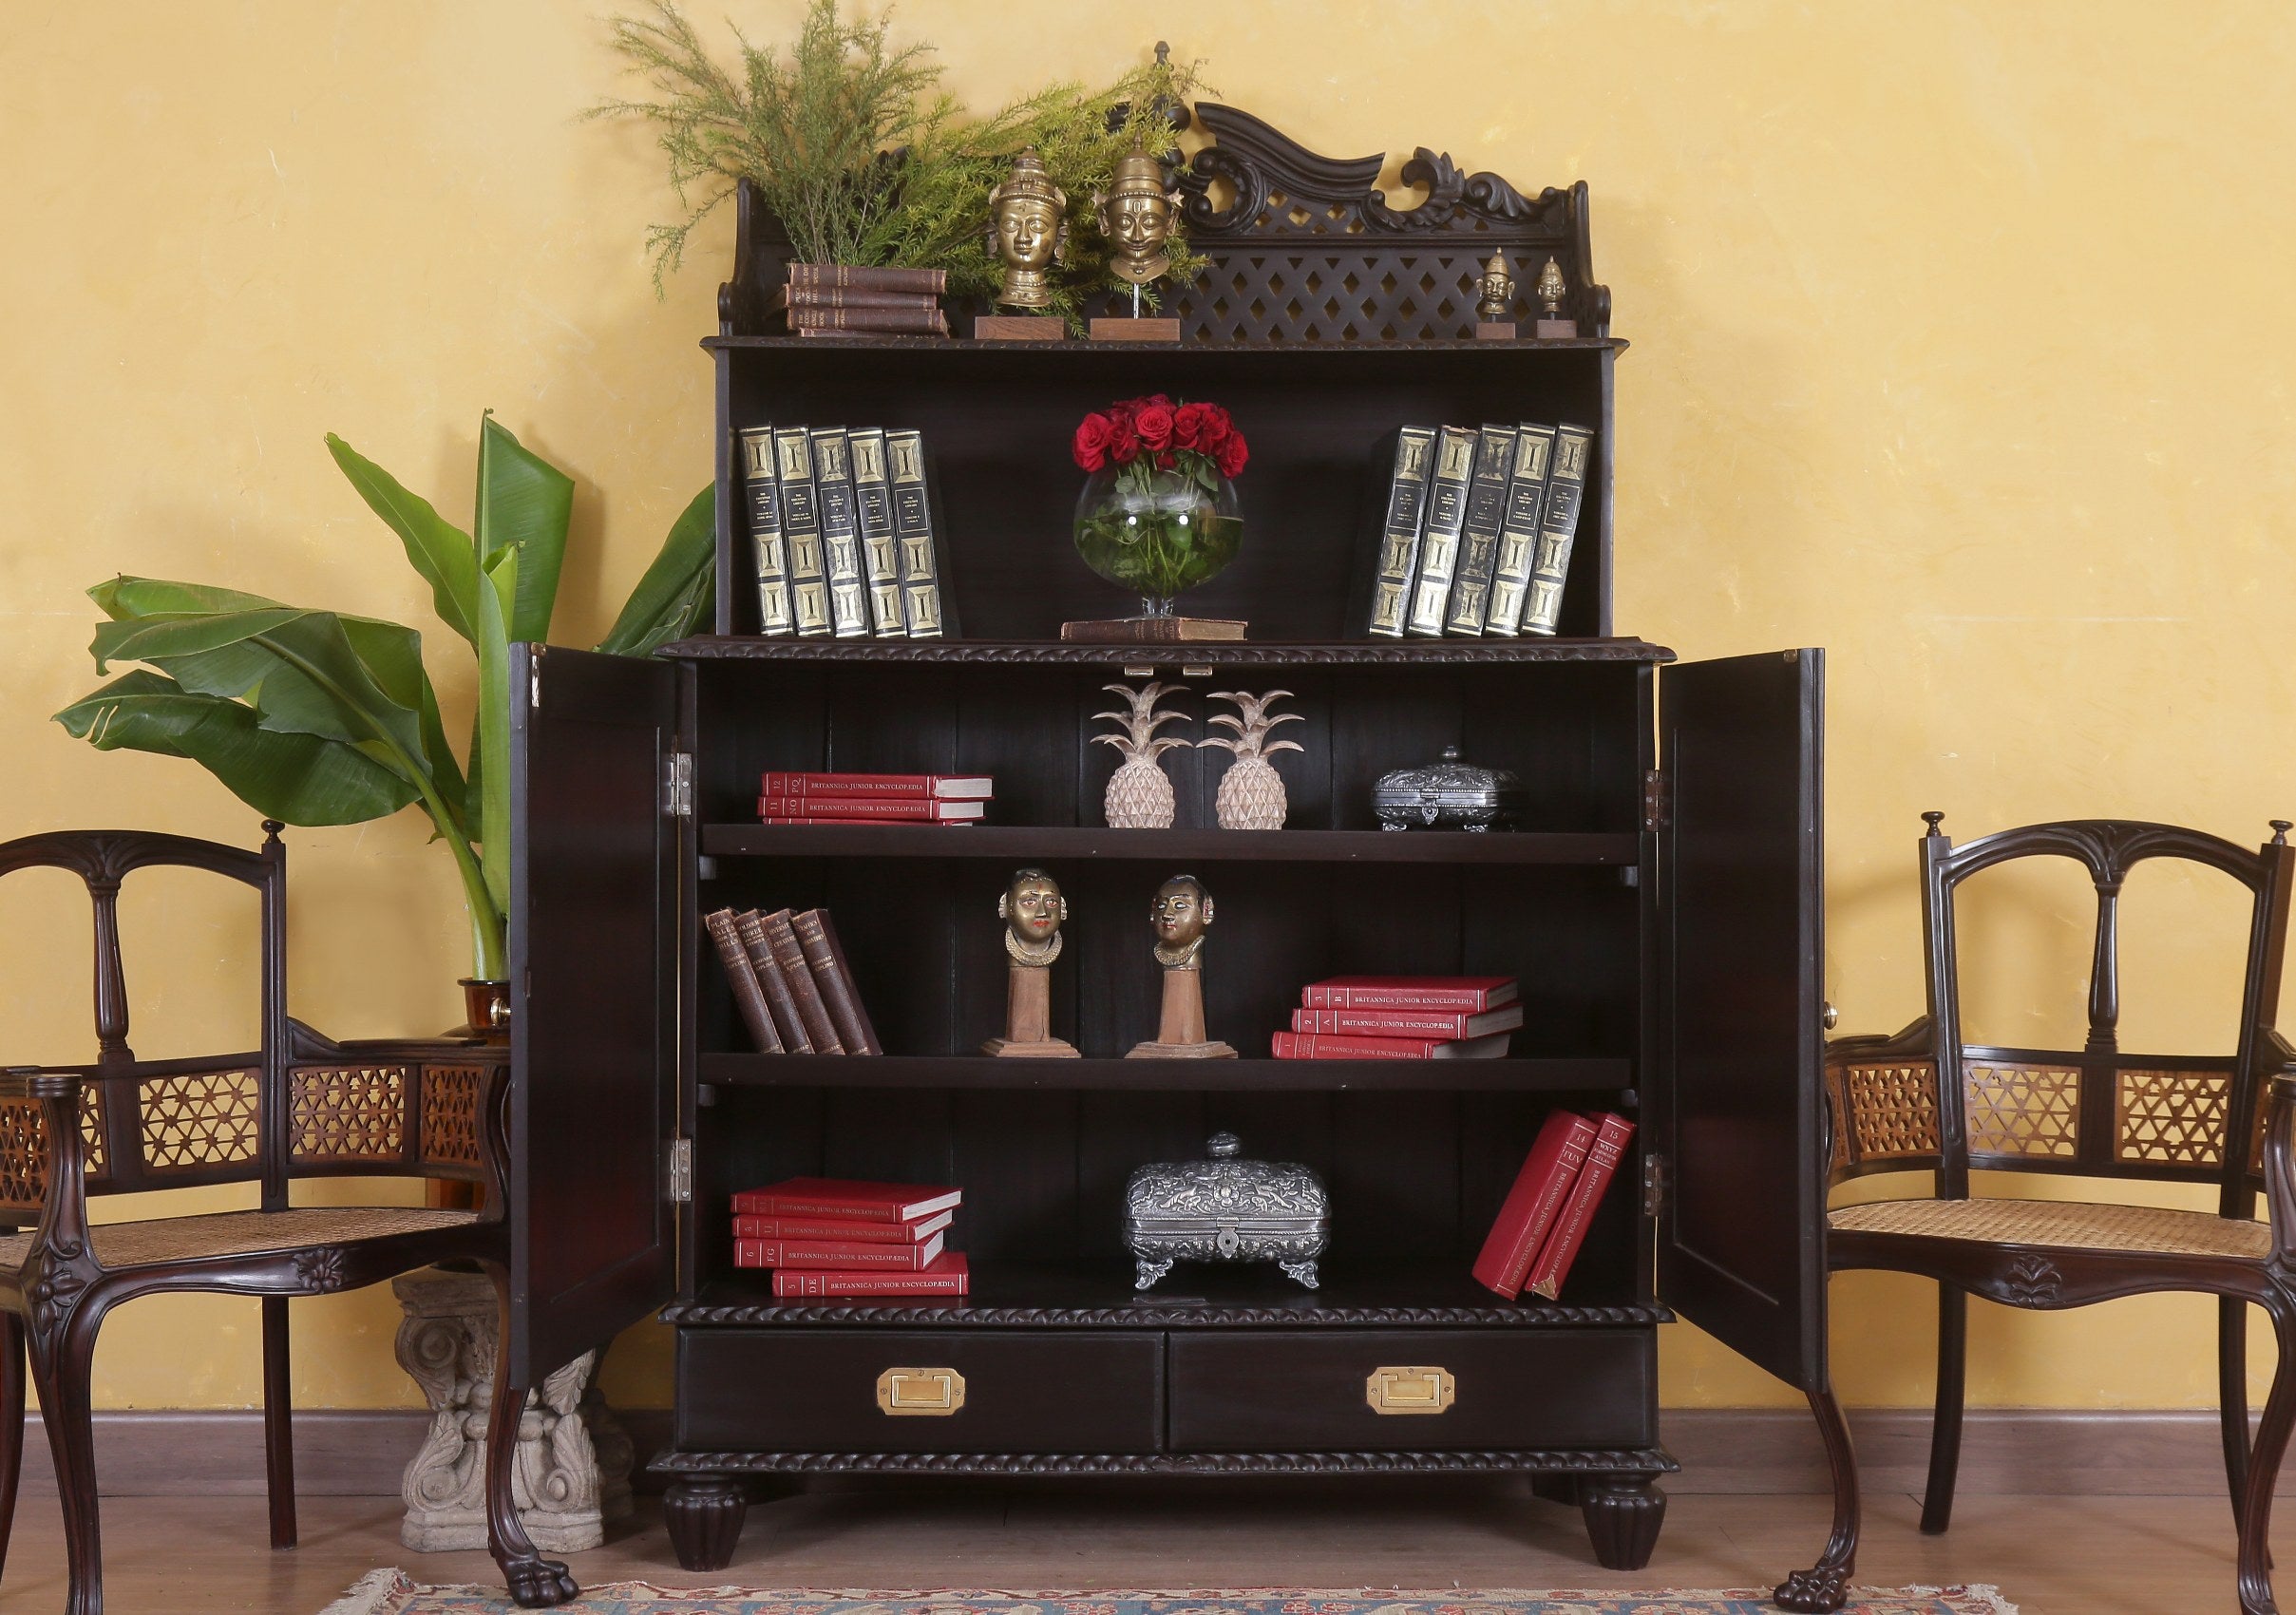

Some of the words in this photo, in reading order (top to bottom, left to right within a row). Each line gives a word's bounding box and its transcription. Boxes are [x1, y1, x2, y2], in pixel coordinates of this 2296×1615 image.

[791, 777, 802, 793] PQ
[811, 782, 849, 790] BRITANNICA
[789, 800, 797, 815] NO
[1406, 1020, 1454, 1030] ENCYCLOPÆDIA
[1319, 1045, 1354, 1054] BRITANNICA
[1354, 1047, 1376, 1055] JUNIOR
[1609, 1130, 1619, 1140] 15
[1600, 1143, 1618, 1154] WXYZ
[1563, 1150, 1583, 1164] TUV
[1545, 1172, 1567, 1210] BRITANNICA
[1579, 1169, 1601, 1208] BRITANNICA
[1535, 1208, 1548, 1235] JUNIOR
[1568, 1207, 1583, 1234] JUNIOR
[768, 1248, 775, 1262] FG
[829, 1253, 855, 1262] JUNIOR
[809, 1279, 817, 1294] DE
